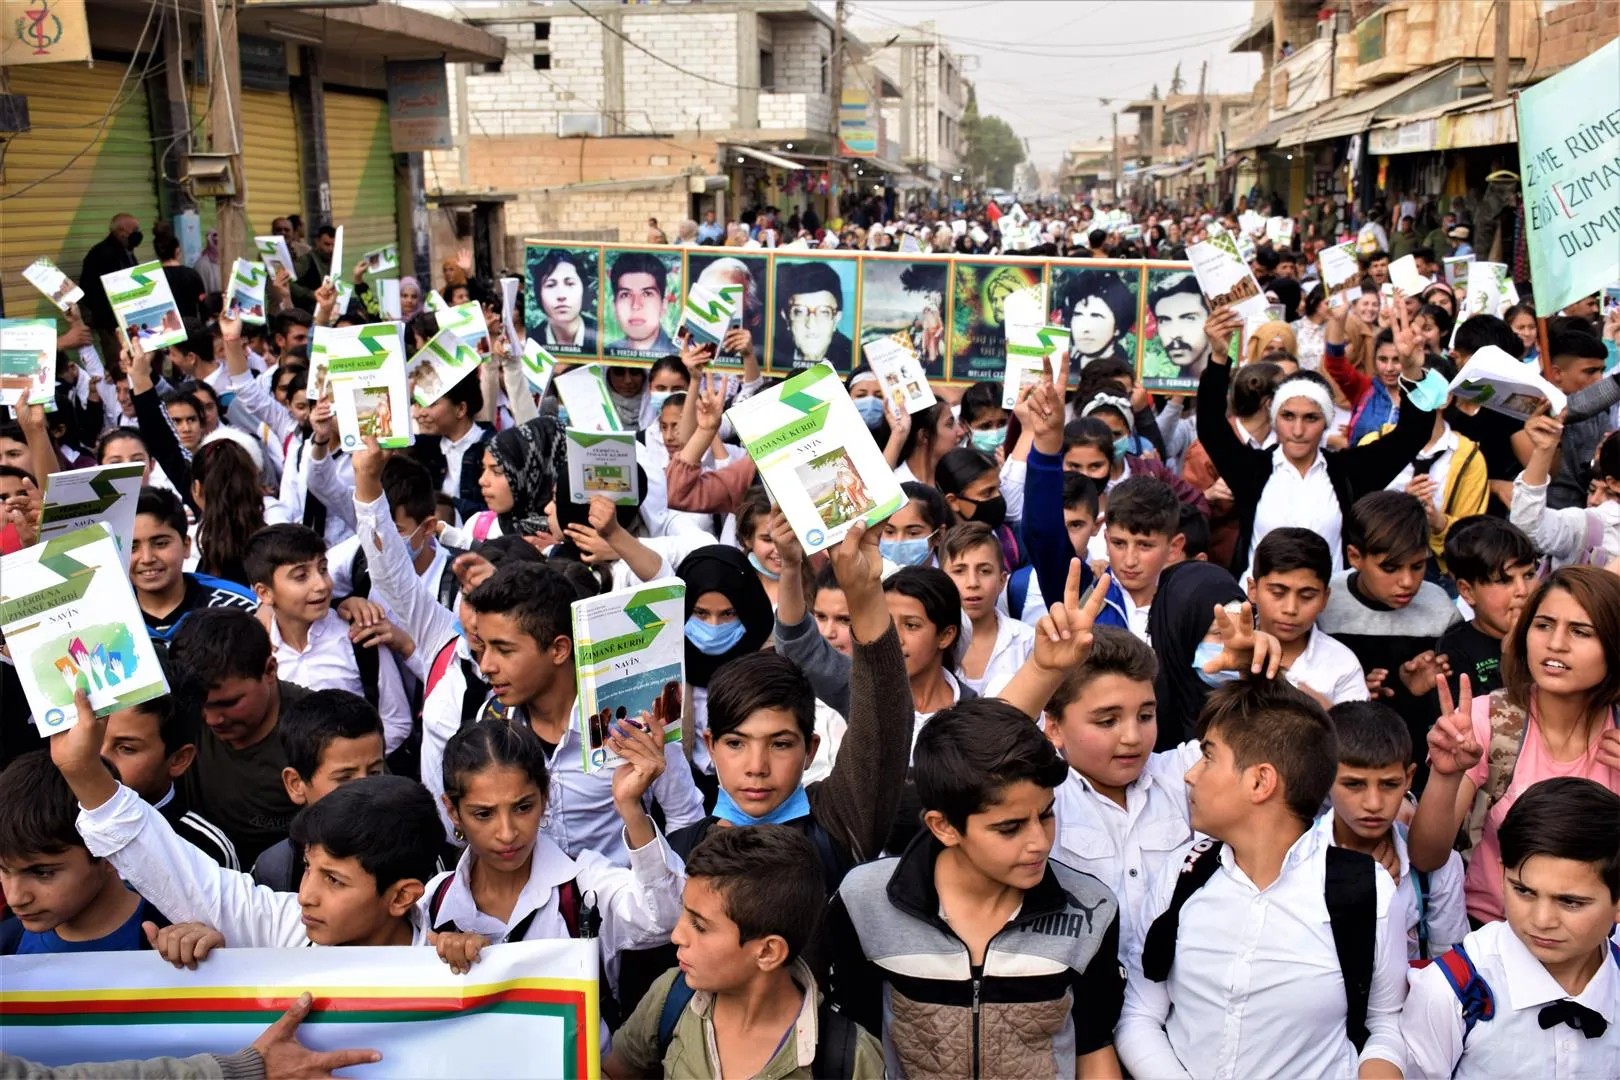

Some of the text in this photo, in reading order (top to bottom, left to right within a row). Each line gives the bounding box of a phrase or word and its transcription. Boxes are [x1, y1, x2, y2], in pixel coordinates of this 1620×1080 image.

[755, 418, 817, 455] ZIMANÊ KURDÎ
[811, 450, 818, 458] 2
[47, 589, 78, 608] KURDÎ
[49, 609, 79, 624] NAVÎN
[582, 635, 645, 661] ZIMANÊ KURDÎ
[615, 656, 640, 670] NAVÎN
